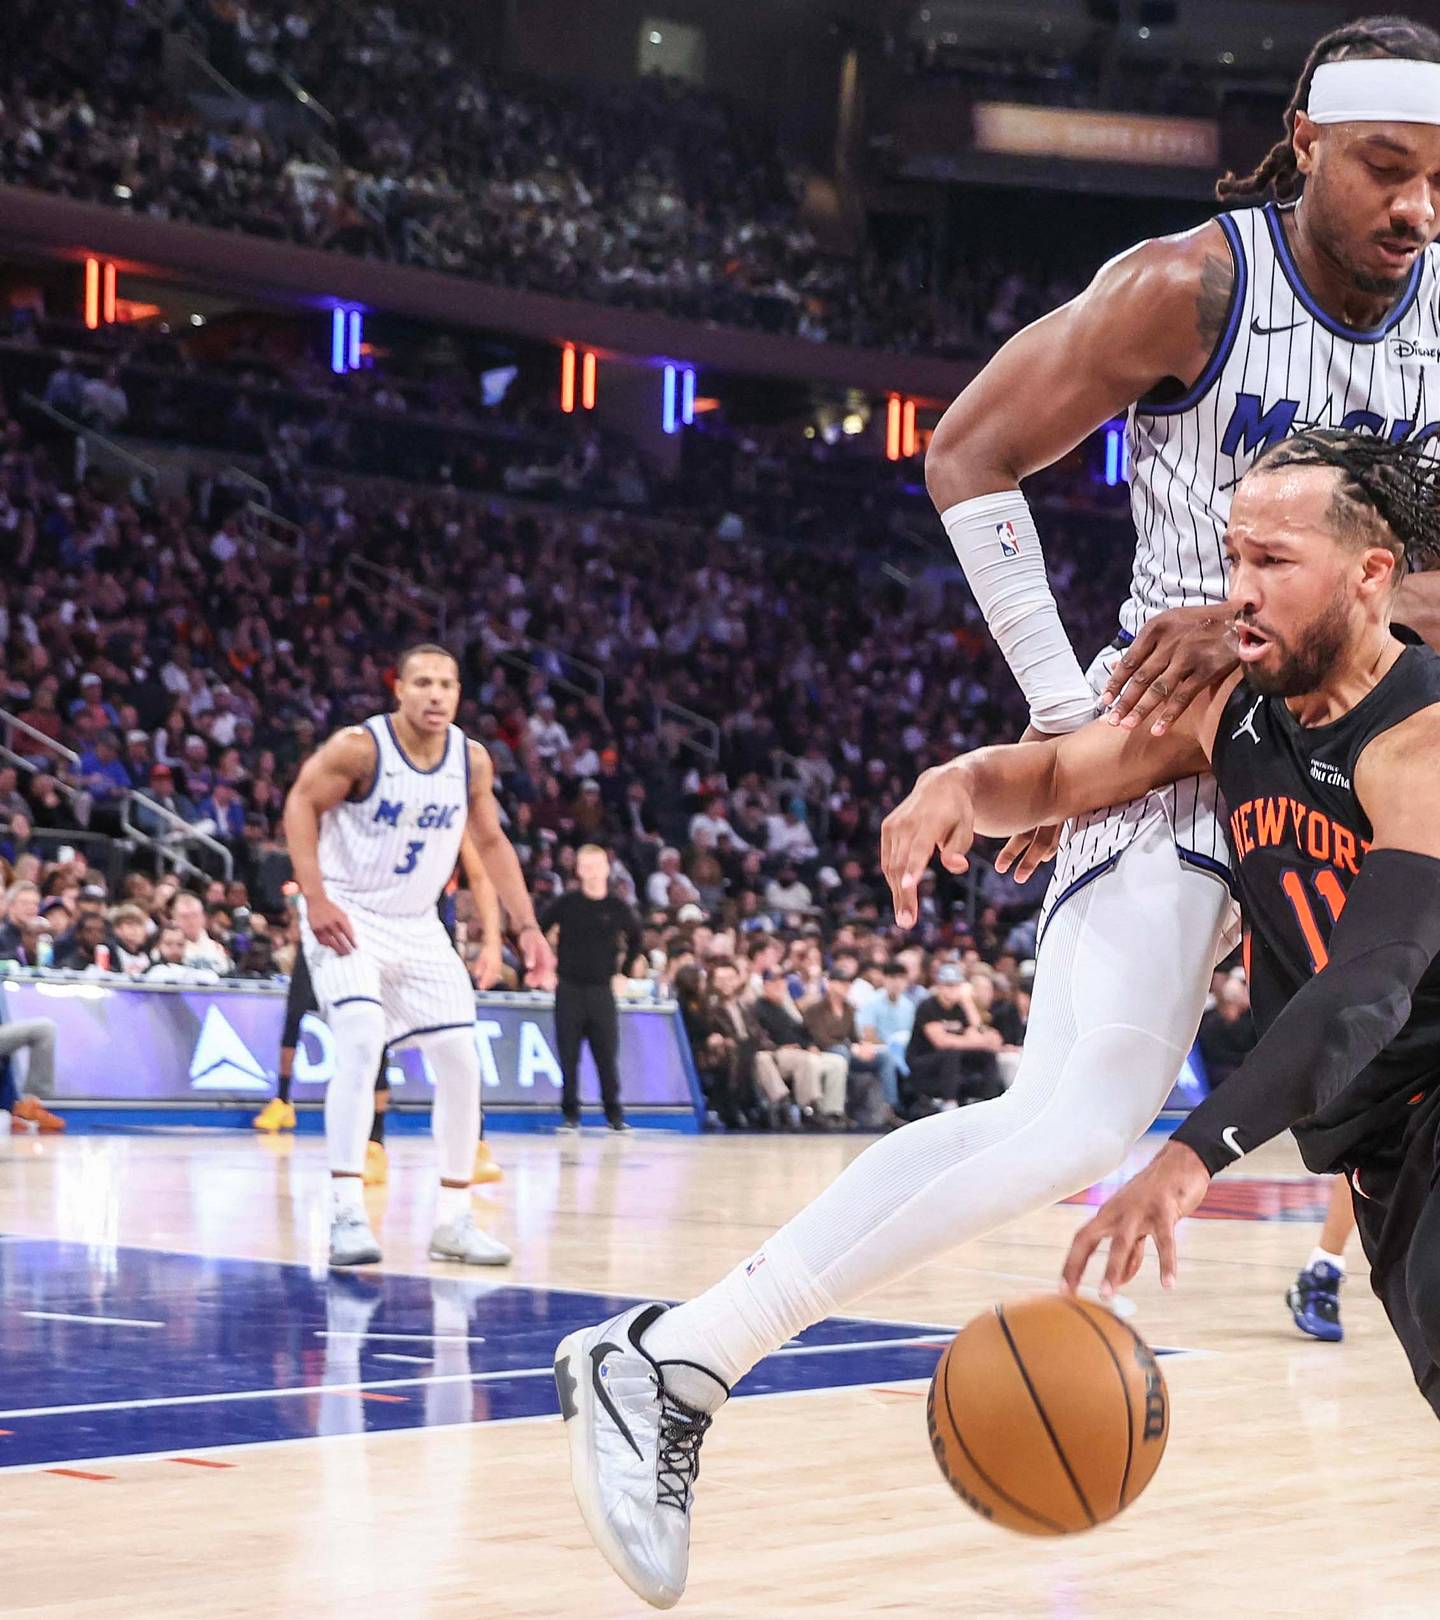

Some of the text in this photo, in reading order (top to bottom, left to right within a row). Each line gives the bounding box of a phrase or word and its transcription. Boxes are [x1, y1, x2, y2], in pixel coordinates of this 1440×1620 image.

[1327, 772, 1350, 790] dha
[373, 798, 459, 828] MGIC
[394, 841, 425, 874] 3
[293, 1014, 564, 1087] DTA
